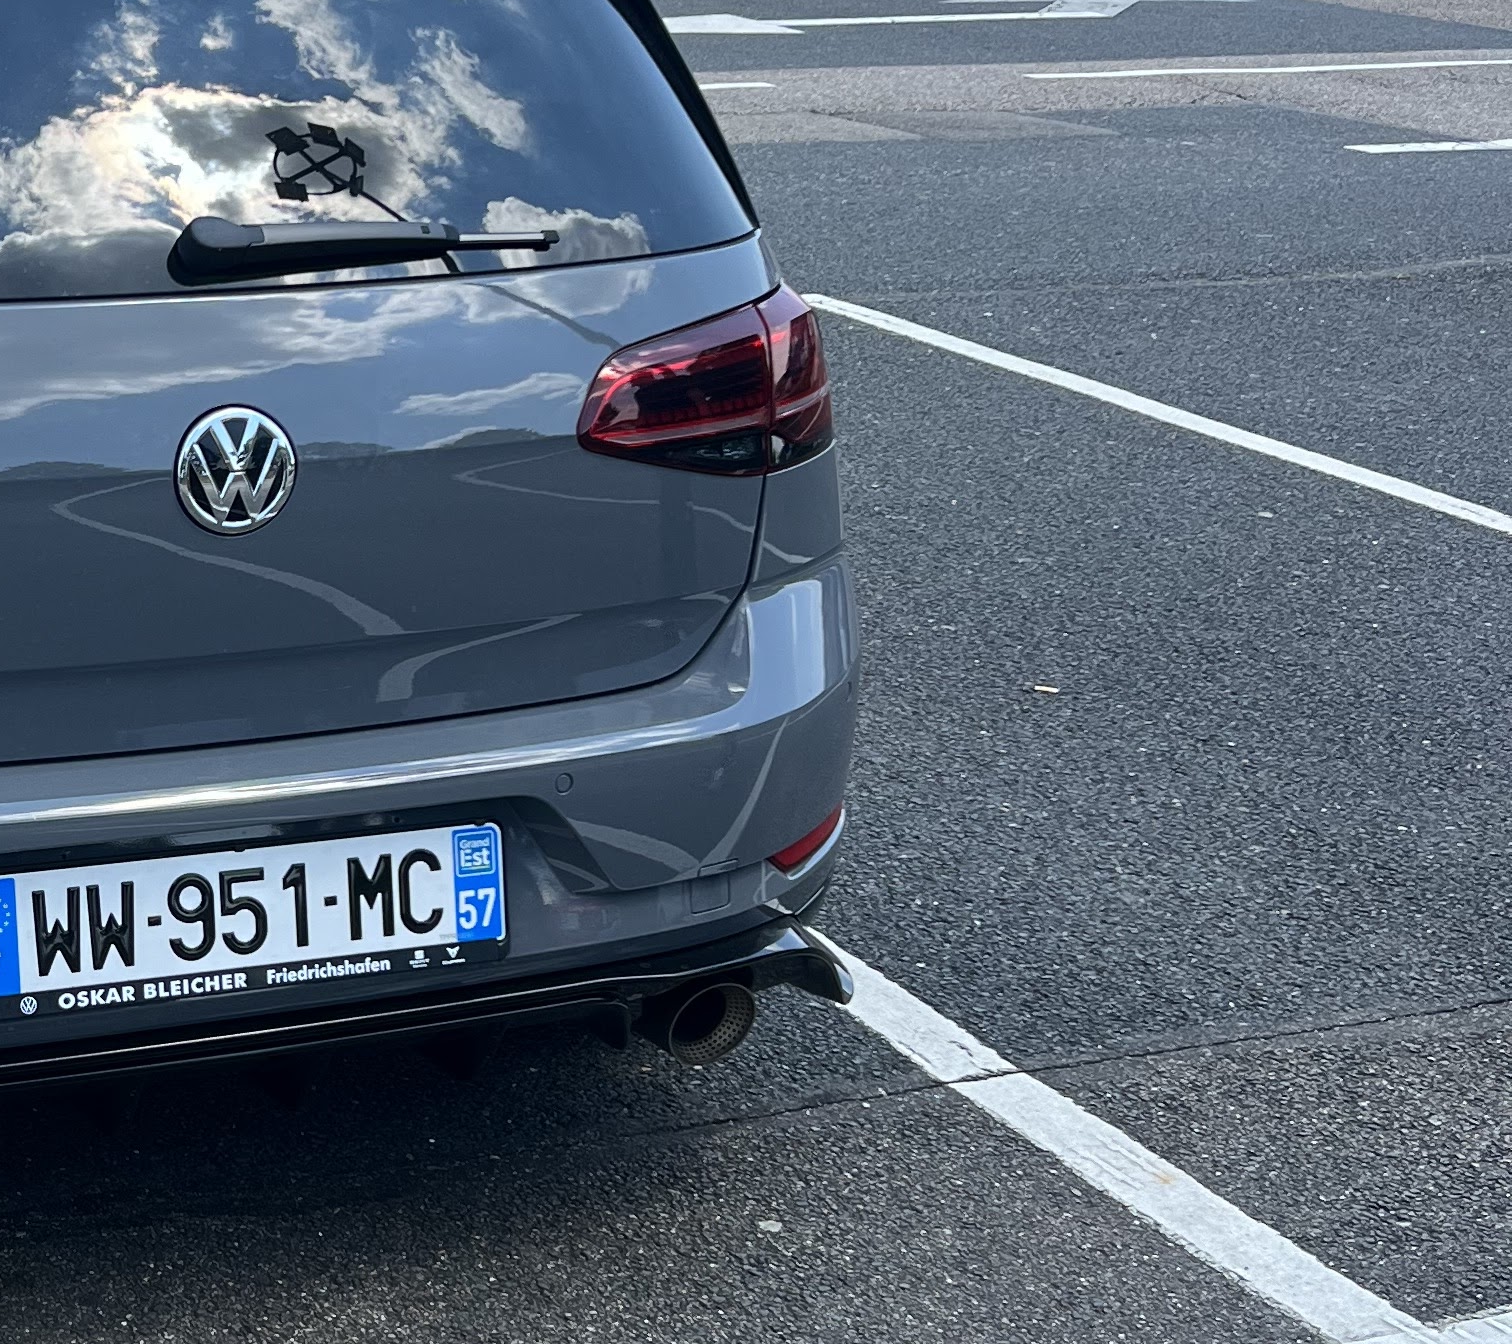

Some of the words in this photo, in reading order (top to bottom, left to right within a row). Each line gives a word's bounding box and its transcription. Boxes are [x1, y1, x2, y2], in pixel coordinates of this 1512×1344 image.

[459, 837, 490, 849] Grand
[460, 847, 490, 867] Est
[32, 848, 444, 977] WW-951-MC
[458, 887, 496, 930] 57
[58, 985, 136, 1010] OSKAR
[143, 972, 248, 1000] BLEICHER
[266, 957, 392, 985] Friedrichshafen
